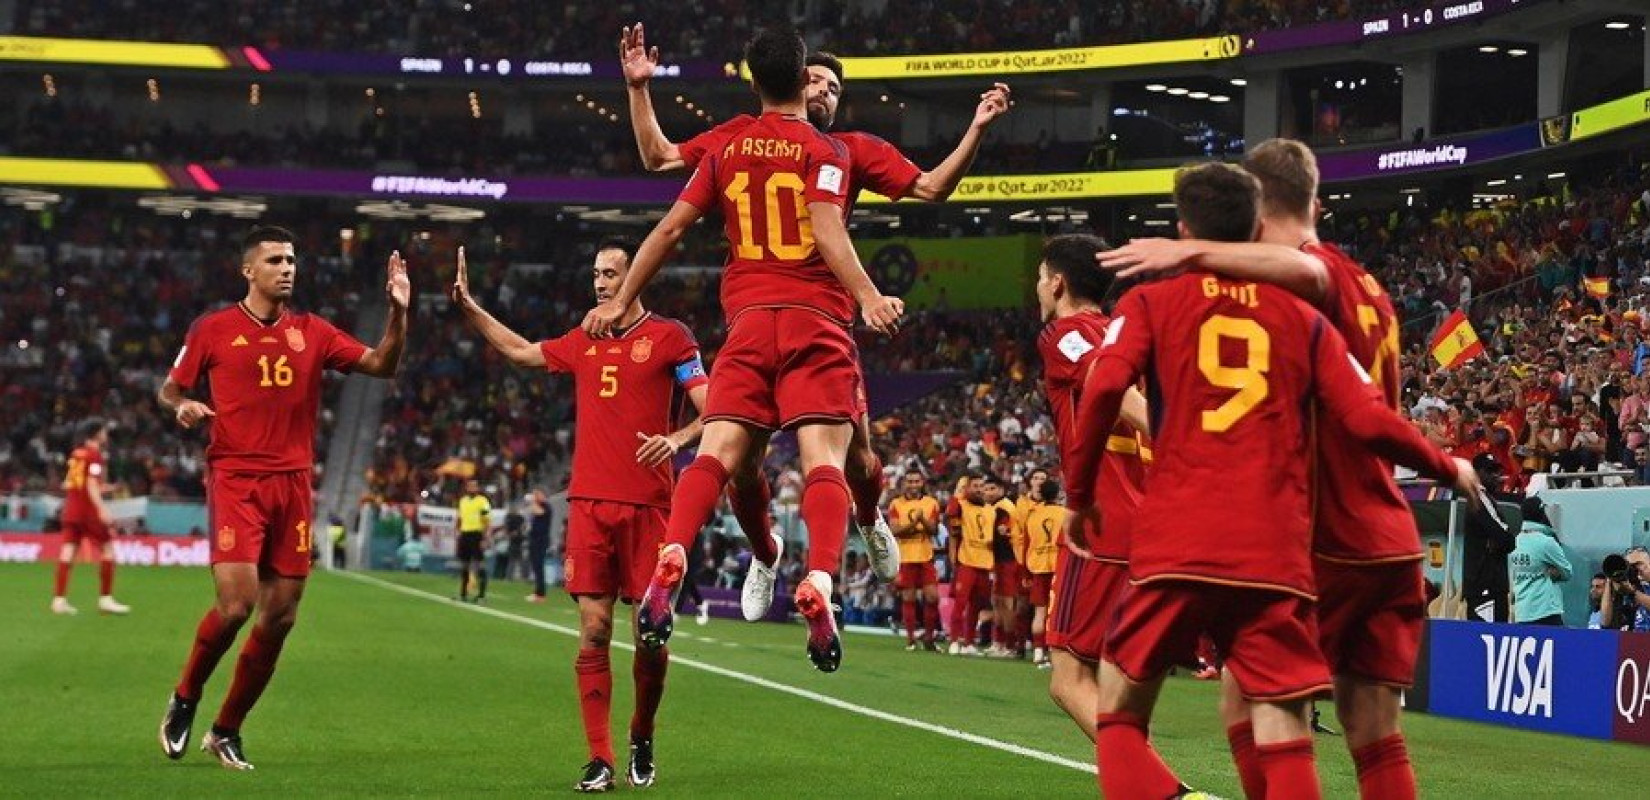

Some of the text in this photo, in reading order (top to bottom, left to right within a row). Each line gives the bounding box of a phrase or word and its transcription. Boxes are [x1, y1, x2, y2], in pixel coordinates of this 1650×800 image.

[1402, 12, 1409, 29] 1
[1424, 9, 1433, 25] 0
[464, 57, 474, 74] 1
[497, 58, 511, 75] 0
[905, 61, 931, 72] FIFA
[933, 59, 975, 71] WORLD
[978, 58, 1001, 69] CUP
[958, 182, 984, 194] CUP
[724, 171, 816, 260] 10
[258, 354, 293, 387] 16
[599, 365, 618, 398] 5
[1199, 314, 1270, 433] 9
[1482, 634, 1554, 718] VISA
